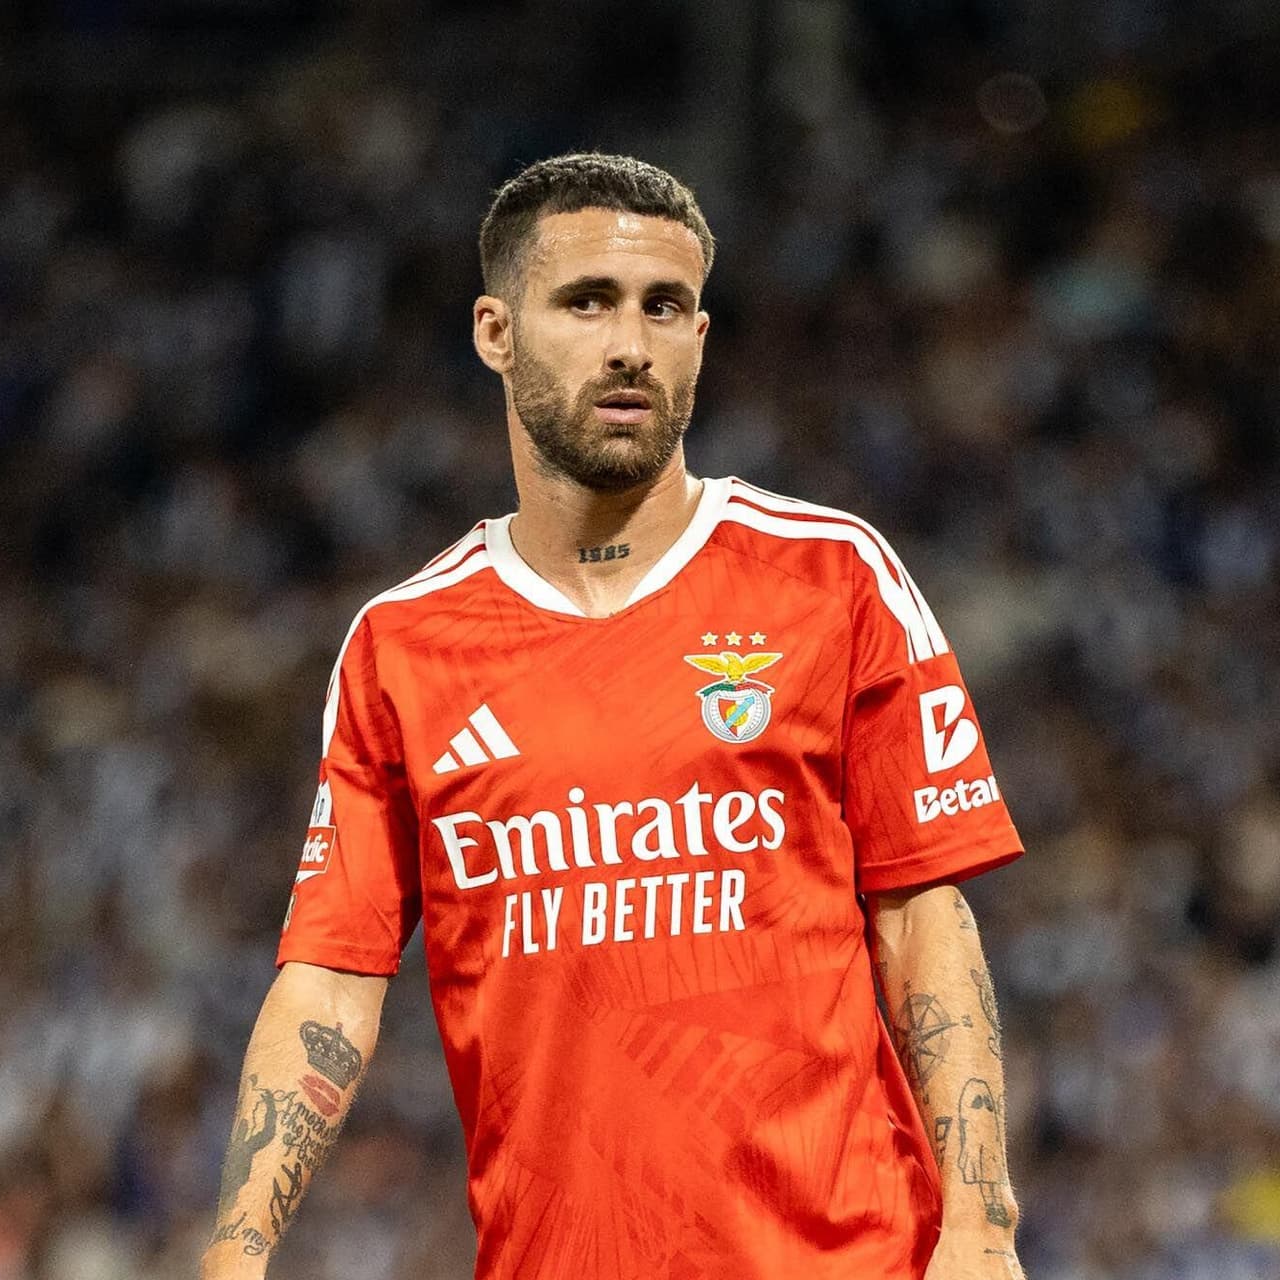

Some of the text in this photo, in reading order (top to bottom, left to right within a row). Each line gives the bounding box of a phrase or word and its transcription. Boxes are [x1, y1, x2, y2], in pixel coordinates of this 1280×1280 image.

[431, 780, 786, 890] Emirates
[502, 868, 746, 958] FLY BETTER
